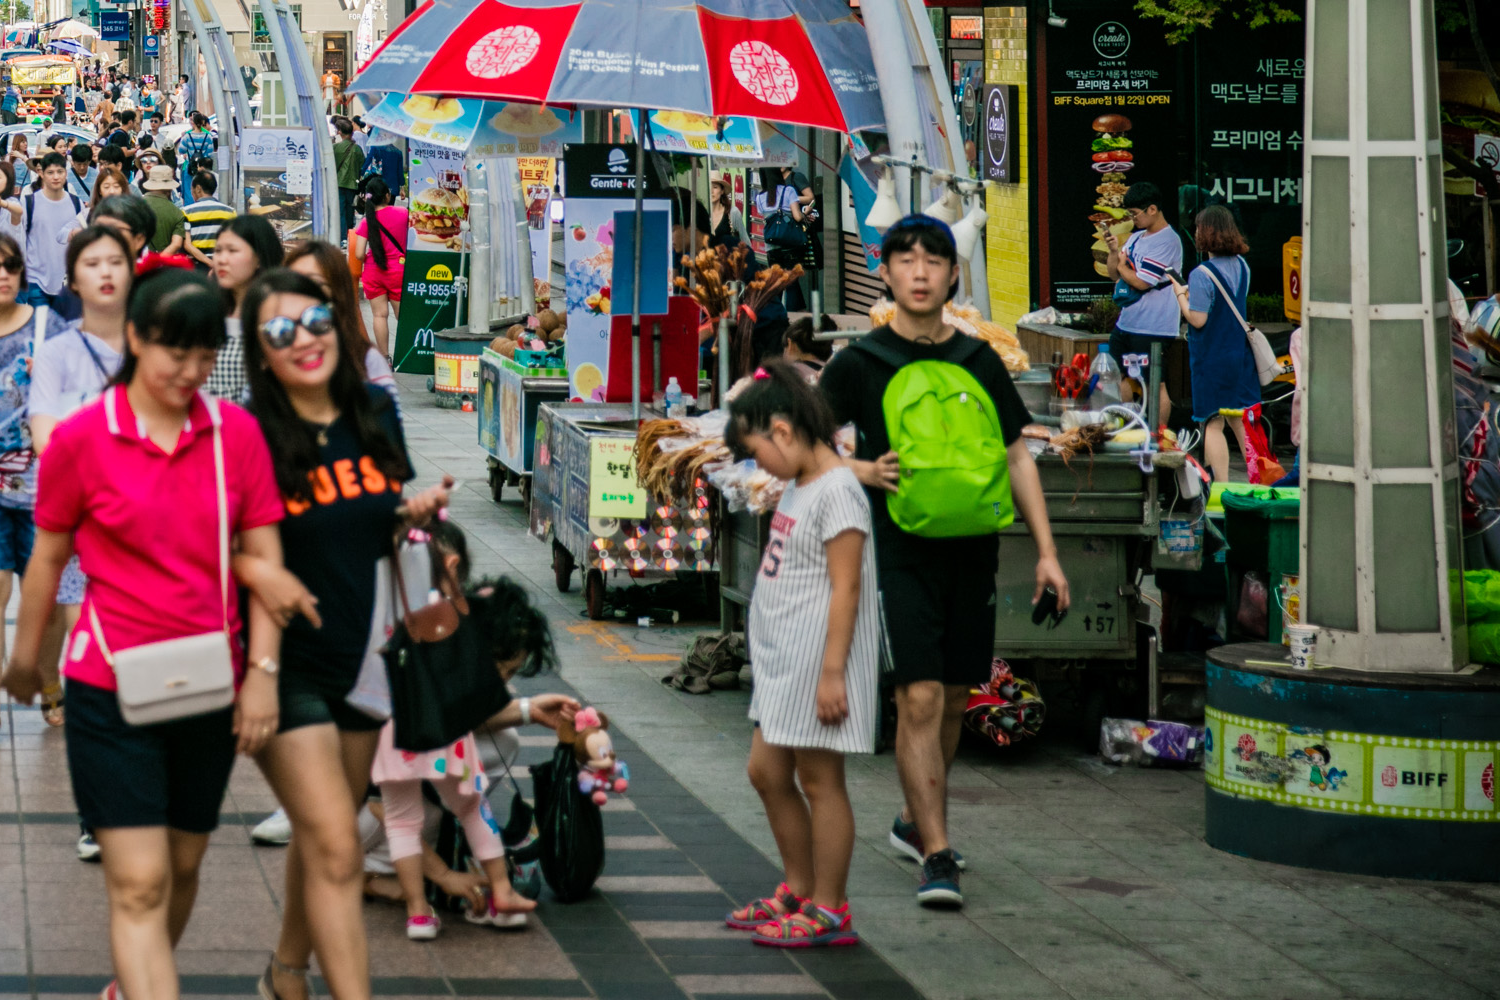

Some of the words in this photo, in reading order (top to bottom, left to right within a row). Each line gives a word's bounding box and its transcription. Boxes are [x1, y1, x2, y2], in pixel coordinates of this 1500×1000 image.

[635, 58, 657, 68] Film
[659, 61, 700, 73] Festival
[1256, 58, 1306, 79] 새로운
[1076, 80, 1110, 90] 프리미엄
[1112, 80, 1130, 90] 수제
[1131, 79, 1149, 90] 버거
[1054, 96, 1072, 105] BIFF
[1073, 96, 1112, 106] Square점
[1146, 95, 1171, 105] OPEN
[1211, 83, 1299, 104] 맥도날드를
[1211, 130, 1281, 151] 프리미엄
[590, 178, 623, 189] Gentle
[430, 270, 450, 278] new
[407, 282, 427, 297] 리우
[428, 283, 450, 297] 1955
[1291, 276, 1298, 294] 2
[285, 454, 402, 517] UES
[1096, 616, 1115, 634] 57
[1401, 771, 1448, 788] BIFF
